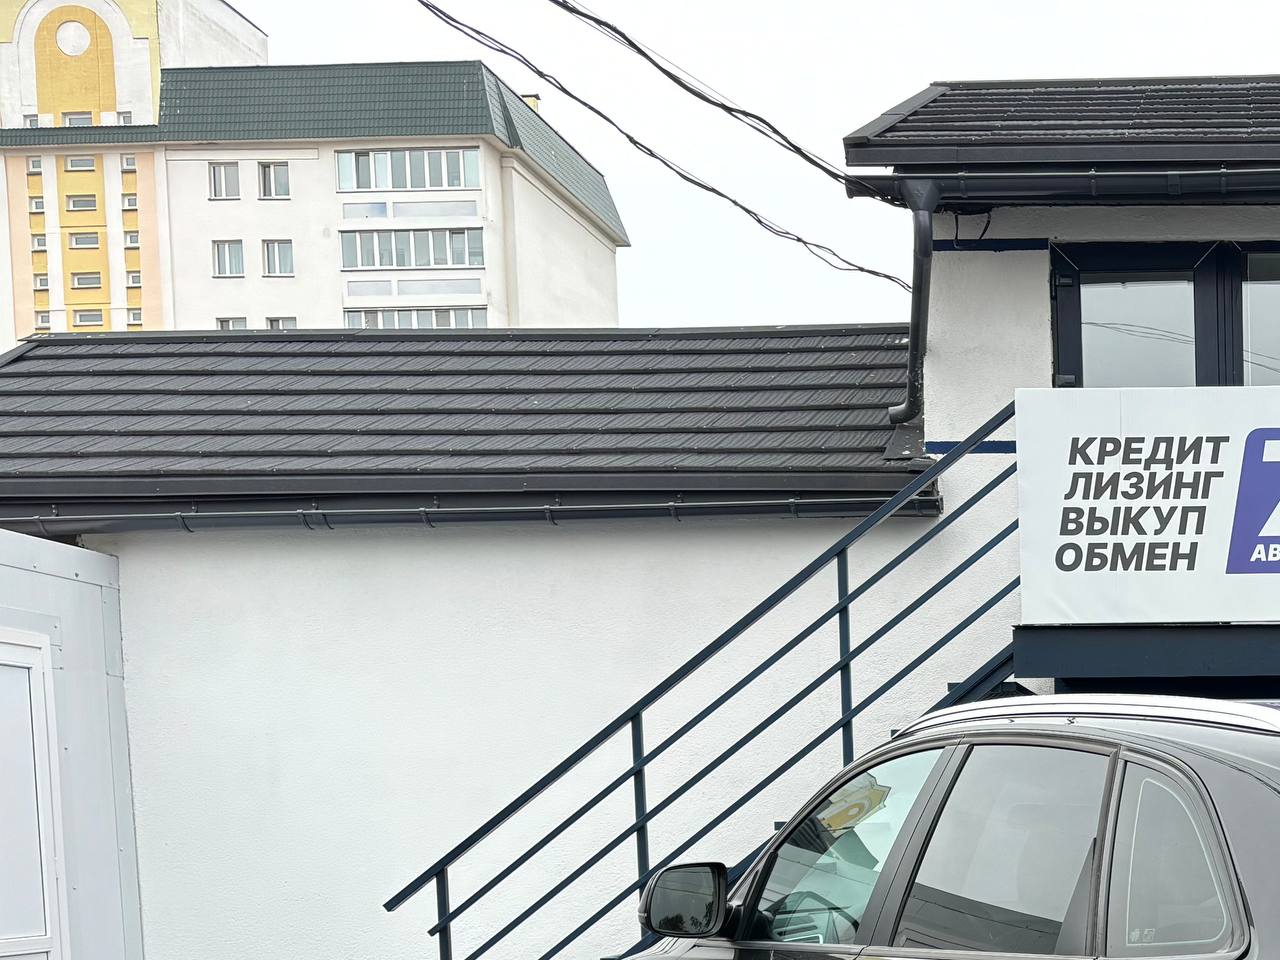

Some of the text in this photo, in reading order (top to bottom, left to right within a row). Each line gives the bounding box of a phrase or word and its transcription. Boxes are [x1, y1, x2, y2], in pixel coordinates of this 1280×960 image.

[1068, 436, 1230, 470] КРЕДИТ
[1063, 471, 1225, 500] ЛИЗИНГ
[1060, 505, 1207, 536] ВЫКУП
[1055, 541, 1199, 572] ОБМЕН
